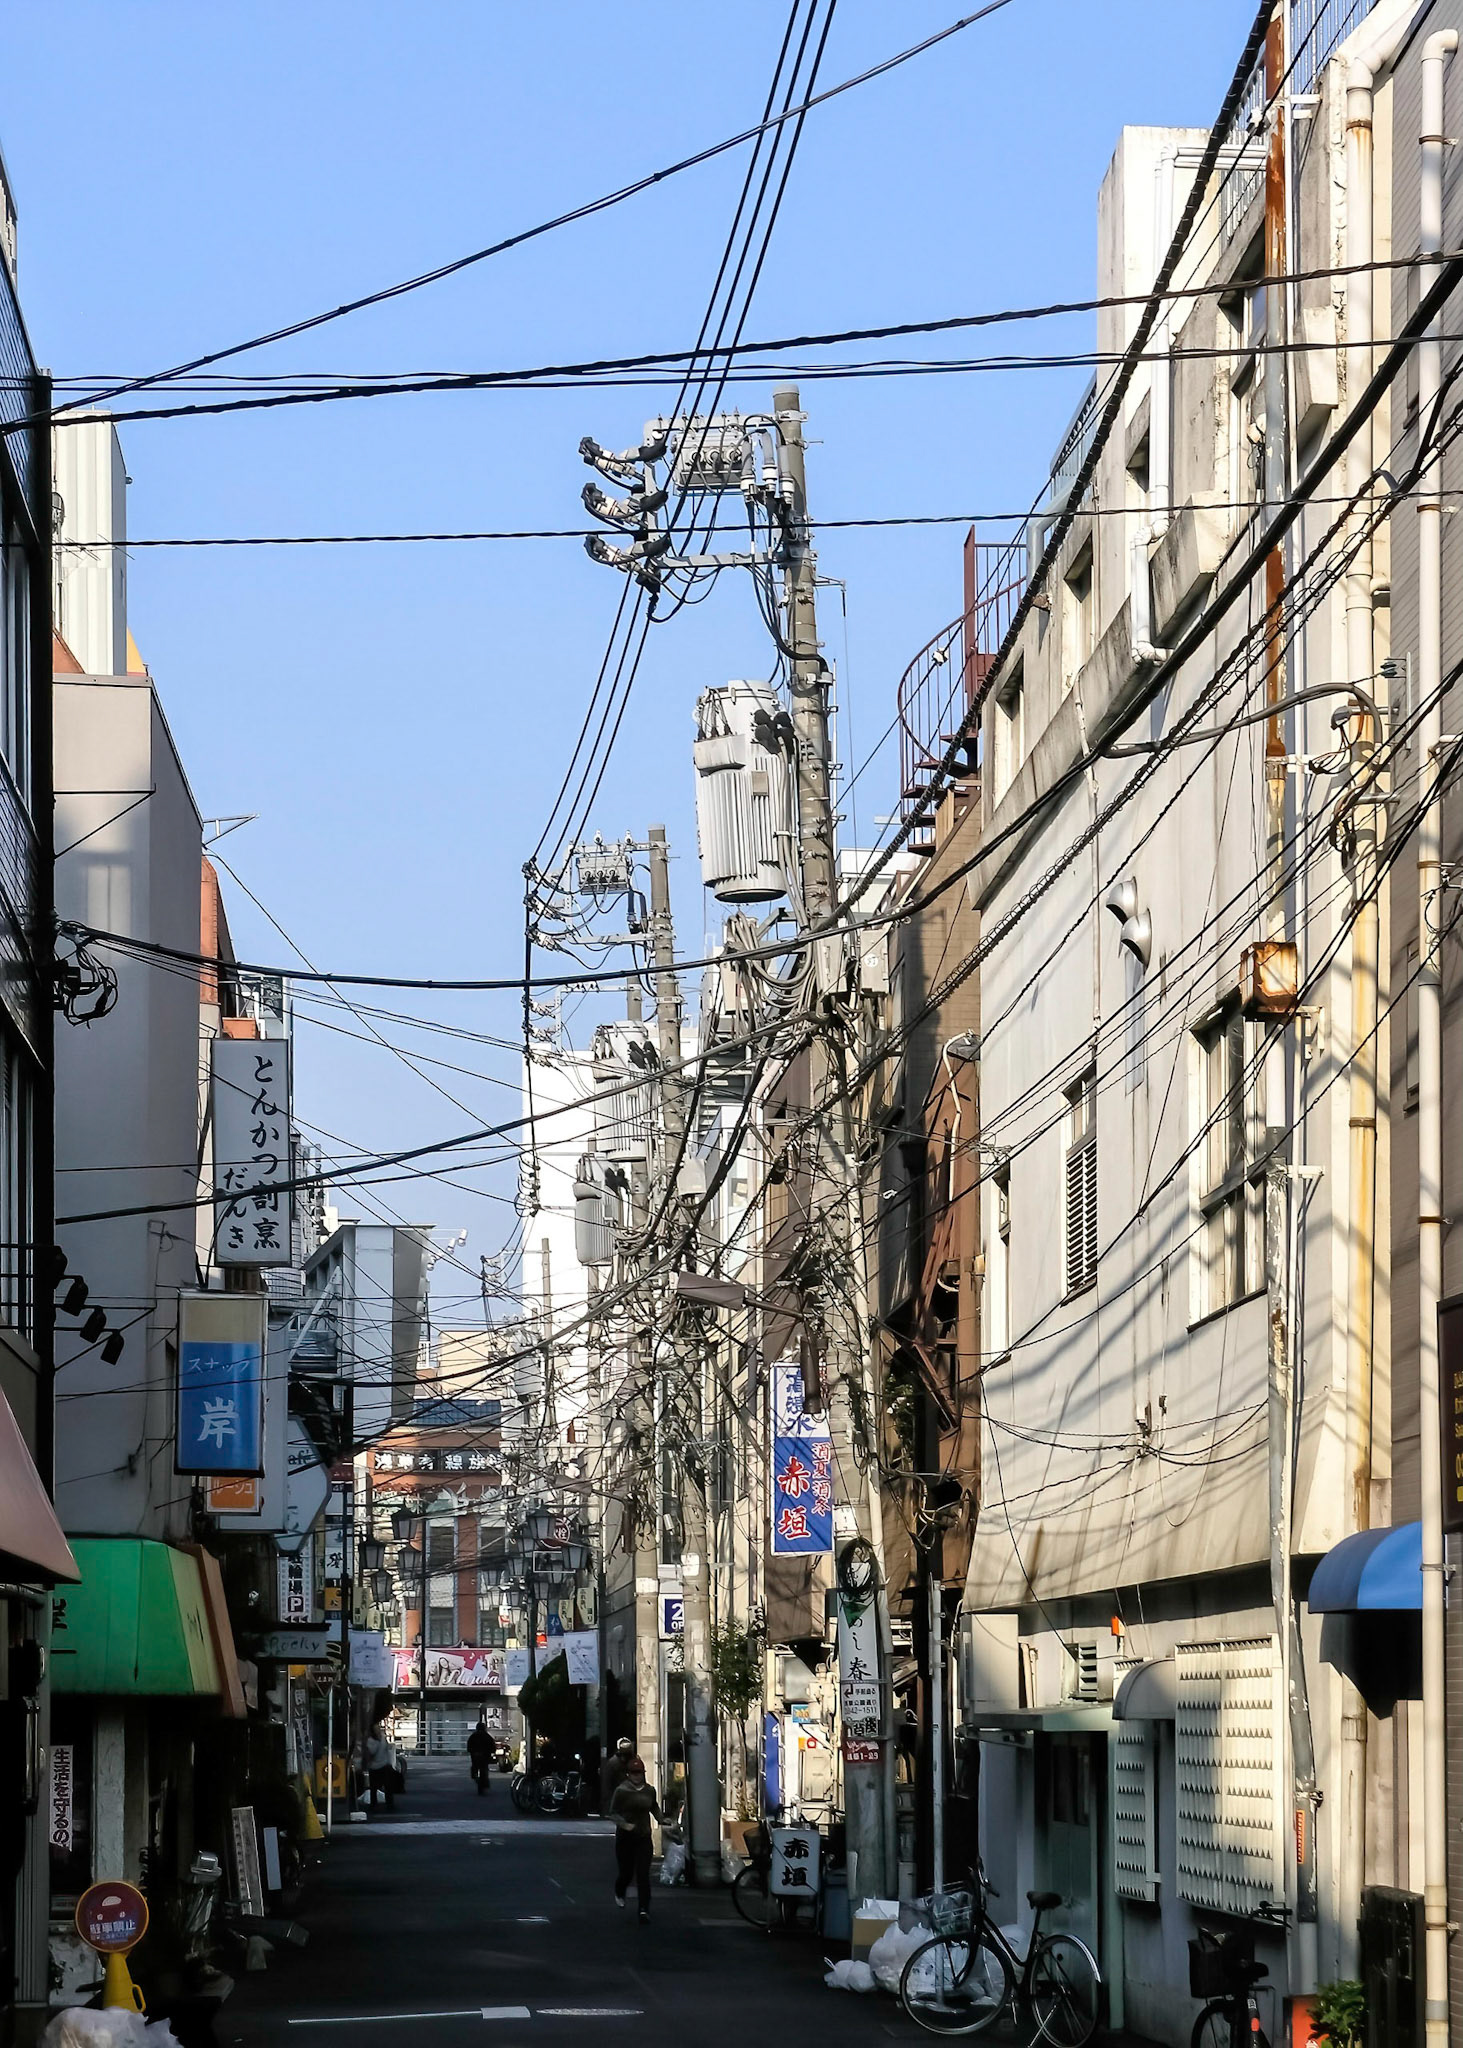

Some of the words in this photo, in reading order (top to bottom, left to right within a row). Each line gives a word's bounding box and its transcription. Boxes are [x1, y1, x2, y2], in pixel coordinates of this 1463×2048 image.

[250, 1055, 280, 1249] とんかつ割烹
[196, 1396, 239, 1449] 岸
[776, 1456, 811, 1540] 赤垣
